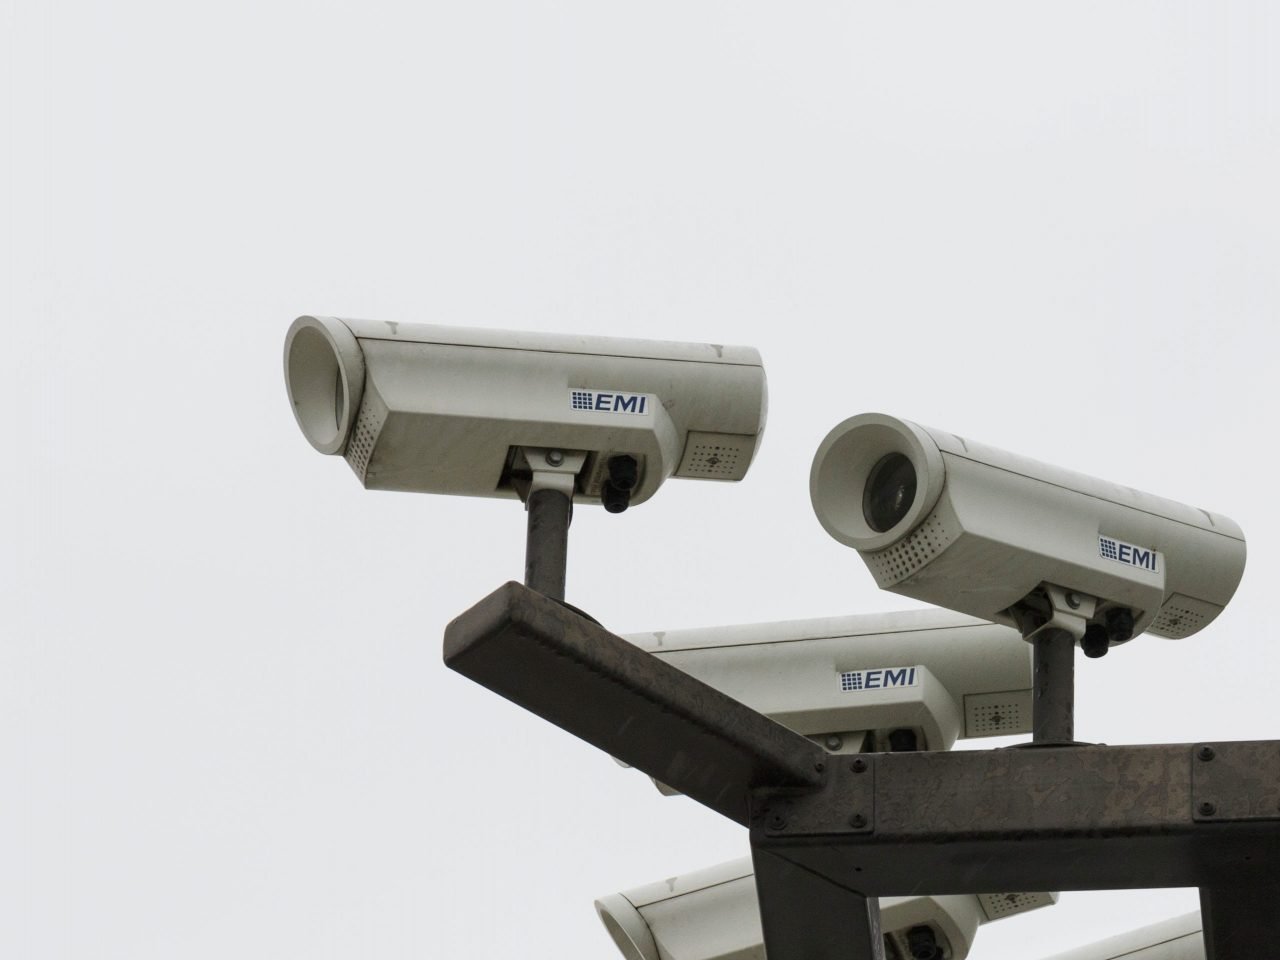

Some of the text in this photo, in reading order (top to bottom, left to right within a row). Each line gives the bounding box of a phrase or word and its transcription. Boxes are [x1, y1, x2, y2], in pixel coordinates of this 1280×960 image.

[594, 393, 646, 413] EMI
[1118, 543, 1156, 571] EMI
[864, 668, 915, 689] EMI
